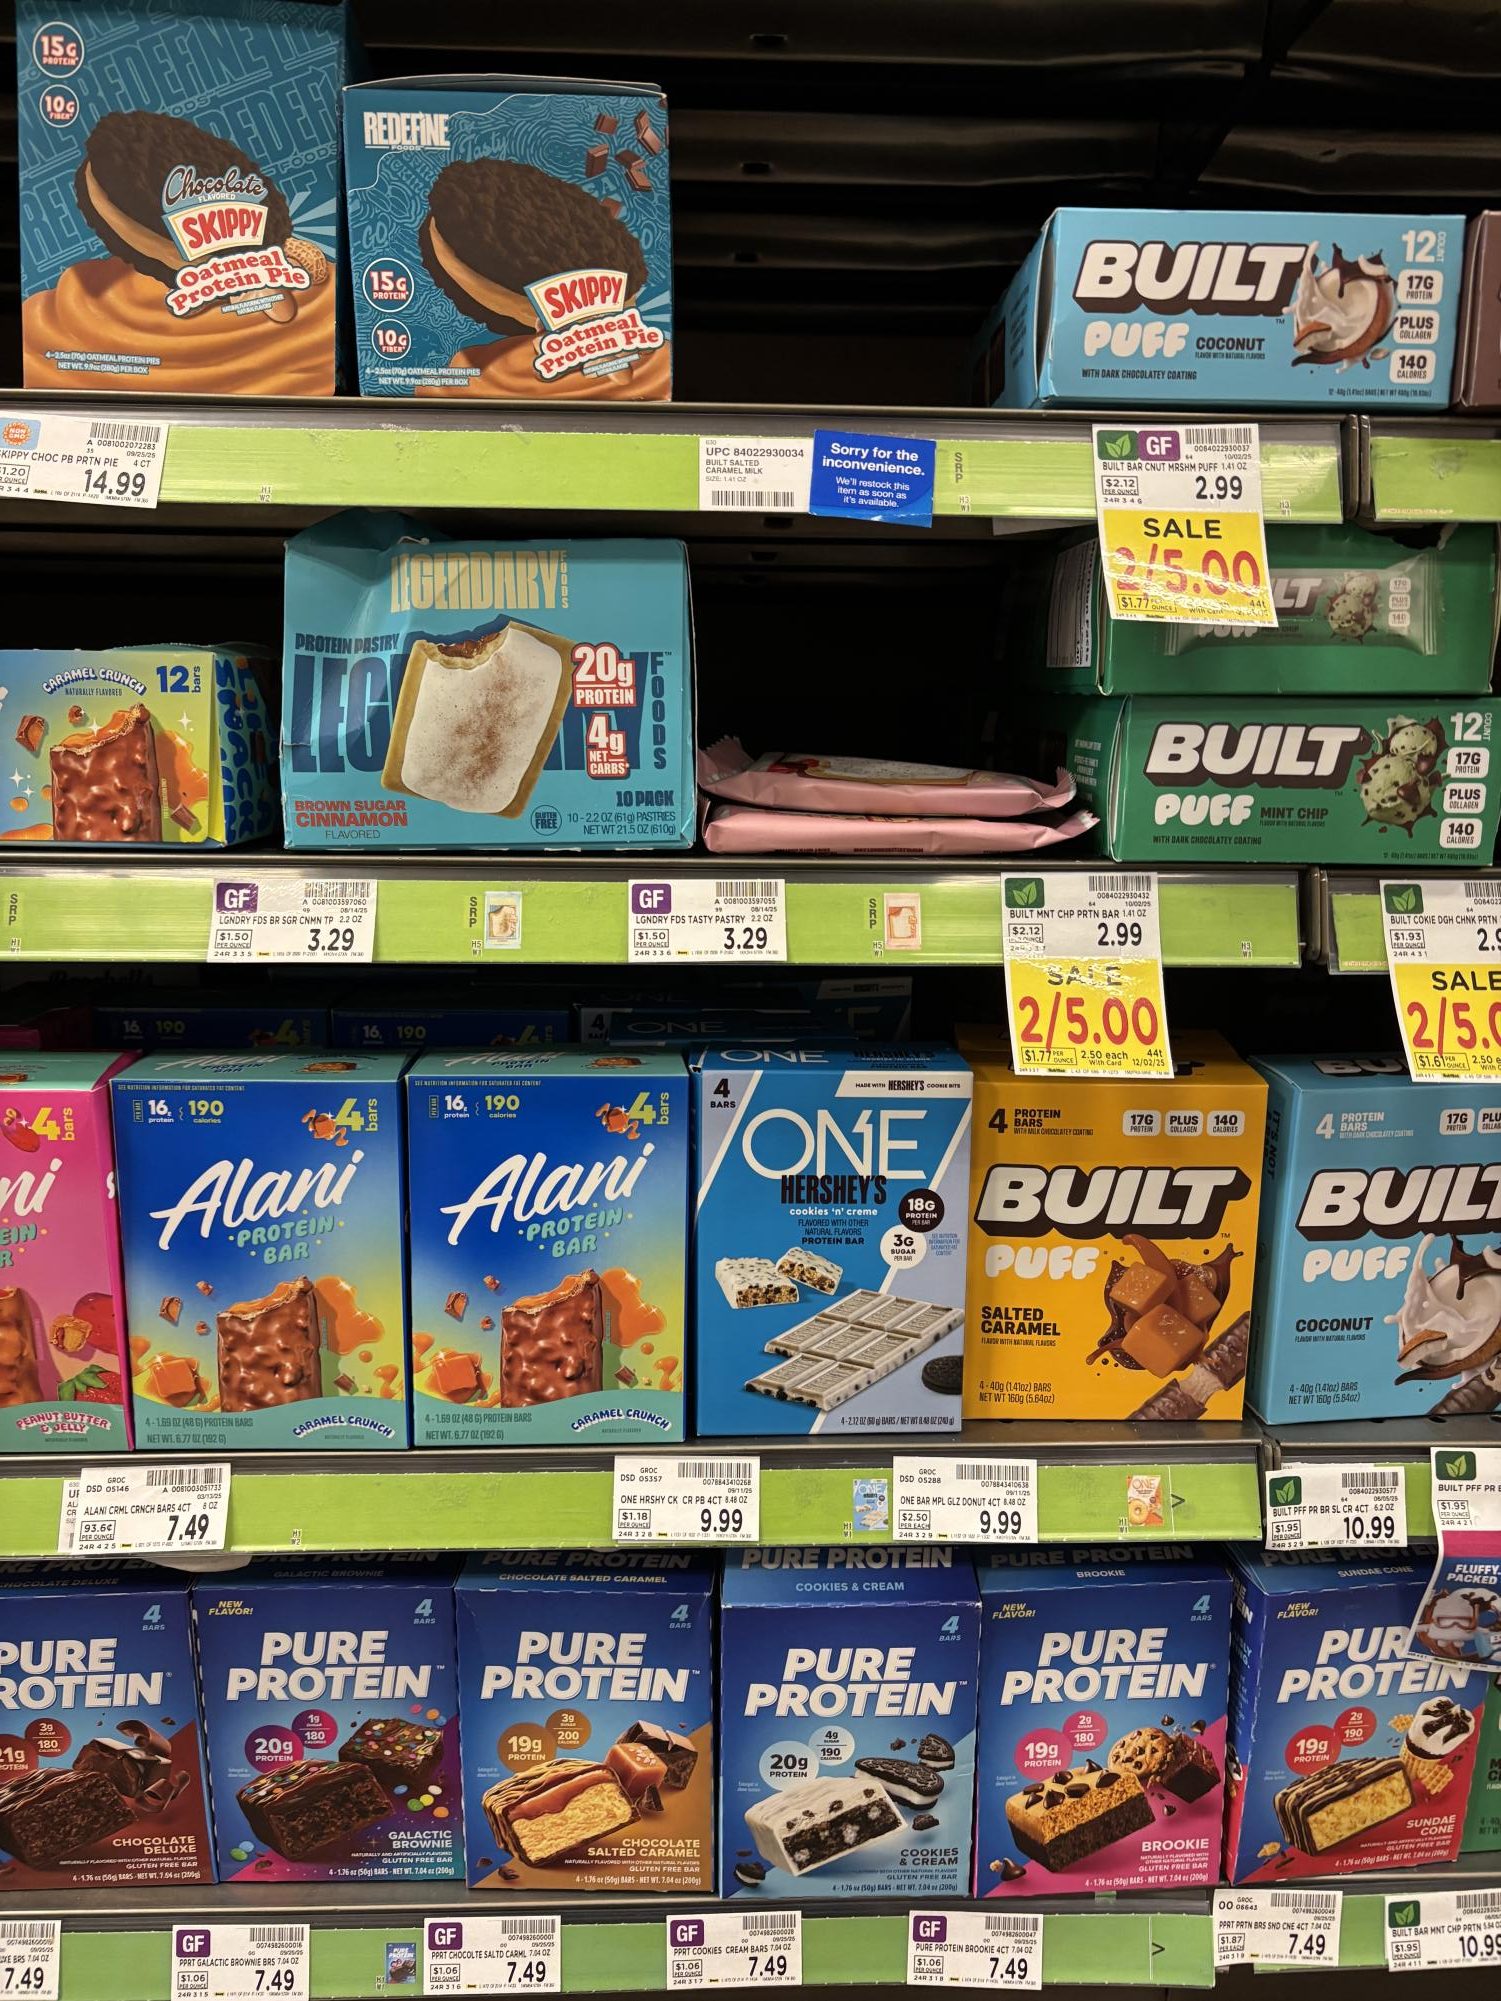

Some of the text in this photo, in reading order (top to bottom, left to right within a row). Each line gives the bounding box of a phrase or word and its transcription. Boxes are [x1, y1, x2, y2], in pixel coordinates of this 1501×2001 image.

[41, 36, 77, 57] 15G
[45, 96, 75, 113] 10G
[364, 112, 450, 146] REDEFINE
[165, 168, 267, 206] Chocolate
[199, 192, 235, 202] FLAVORED
[182, 209, 262, 249] SKIPPY
[1402, 230, 1435, 262] 12
[181, 250, 283, 287] Oatmeal
[1074, 241, 1311, 310] BUILT
[171, 273, 260, 314] Protein
[269, 266, 305, 291] Pie
[1407, 275, 1433, 290] 17G
[545, 277, 622, 318] SKIPPY
[1084, 321, 1189, 357] PUFF
[1196, 338, 1265, 352] COCONUT
[706, 447, 804, 457] UPC 84022930034
[831, 443, 918, 461] Sorry for the
[1146, 437, 1171, 455] GF
[31, 452, 118, 467] CHOC PB PRTN PIE
[730, 459, 759, 467] SALTED
[823, 457, 924, 476] inconvenience.
[1128, 463, 1142, 471] BAR
[1145, 463, 1165, 471] CNUT
[1169, 463, 1196, 472] MRSHM
[1199, 463, 1218, 472] PUFF
[85, 469, 146, 496] 14.99
[836, 477, 909, 490] We'll restock this
[1106, 479, 1135, 487] $2.12
[1196, 476, 1242, 499] 2.99
[838, 487, 857, 495] item
[872, 490, 893, 498] soon
[844, 495, 899, 508] it's available.
[1144, 518, 1222, 539] SALE
[391, 551, 559, 612] LEGENDARY
[296, 633, 399, 650] PROTEIN PASTRY
[575, 647, 633, 686] 20g
[43, 668, 147, 695] CARAMEL CRUNCH
[157, 666, 200, 693] 12 bars
[576, 689, 634, 705] PROTEIN
[589, 716, 623, 755] 4g
[1451, 712, 1482, 741] 12
[590, 751, 607, 762] NET
[1144, 722, 1365, 784] BUILT
[1456, 752, 1480, 765] 17G
[296, 801, 405, 812] BROWN SUGAR
[617, 791, 674, 806] 10 PACK
[1449, 800, 1479, 809] COLLAGEN
[1154, 794, 1255, 825] PUFF
[1261, 807, 1328, 819] MINT CHIP
[296, 813, 407, 826] CINNAMON
[326, 830, 380, 839] FLAVORED
[1447, 836, 1474, 844] CALORIES
[639, 889, 663, 907] GF
[636, 916, 745, 924] LGNDRY FDS TASTY PASTRY
[308, 928, 354, 950] 3.29
[638, 932, 666, 940] $1.50
[724, 927, 767, 949] 3.29
[1098, 923, 1142, 946] 2.99
[1019, 992, 1158, 1051] 2/5.00
[1106, 1051, 1128, 1059] each
[714, 1078, 730, 1098] 4
[485, 1095, 520, 1110] 190
[335, 1099, 378, 1131] 4 bars
[742, 1109, 928, 1180] ONE
[441, 1143, 655, 1245] Alani
[781, 1175, 887, 1204] HERSHEY'S
[150, 1150, 364, 1250] Alani
[908, 1198, 935, 1210] 18G
[975, 1164, 1246, 1235] BUILT
[790, 1207, 878, 1216] cookies creme
[237, 1215, 335, 1247] PROTEIN
[264, 1246, 309, 1264] BAR
[985, 1245, 1099, 1280] PUFF
[1303, 1247, 1410, 1282] PUFF
[981, 1306, 1043, 1320] SALTED
[981, 1321, 1060, 1336] CARAMEL
[1295, 1317, 1373, 1333] COCONUT
[621, 1495, 722, 1504] ONE HRSHY CK CR PB 4CT
[85, 1503, 191, 1515] ALANI CRML CRNCH BARS 4CT
[167, 1514, 209, 1541] 7.49
[701, 1509, 742, 1532] 9.99
[1344, 1516, 1394, 1538] 10.99
[796, 1582, 905, 1591] COOKIES & CREAM
[1447, 1573, 1497, 1584] PACKED
[261, 1631, 388, 1666] PURE
[517, 1631, 647, 1665] PURE
[783, 1647, 916, 1682] PURE
[227, 1665, 431, 1701] PROTEIN
[480, 1666, 690, 1702] PROTEIN
[744, 1681, 957, 1717] PROTEIN
[255, 1738, 293, 1755] 20g
[770, 1754, 808, 1771] 20g
[1407, 1815, 1456, 1828] SUNDAE
[1421, 1825, 1454, 1834] CONE
[113, 1836, 195, 1847] CHOCOLATE
[1142, 1839, 1209, 1851] BROOKIE
[588, 1847, 700, 1857] SALTED CARAMEL
[916, 1944, 1009, 1954] PURE PROTEIN BROOKIE 4CT
[1289, 1934, 1325, 1955] 7.49
[507, 1961, 546, 1983] 7.49
[990, 1958, 1027, 1979] 7.49
